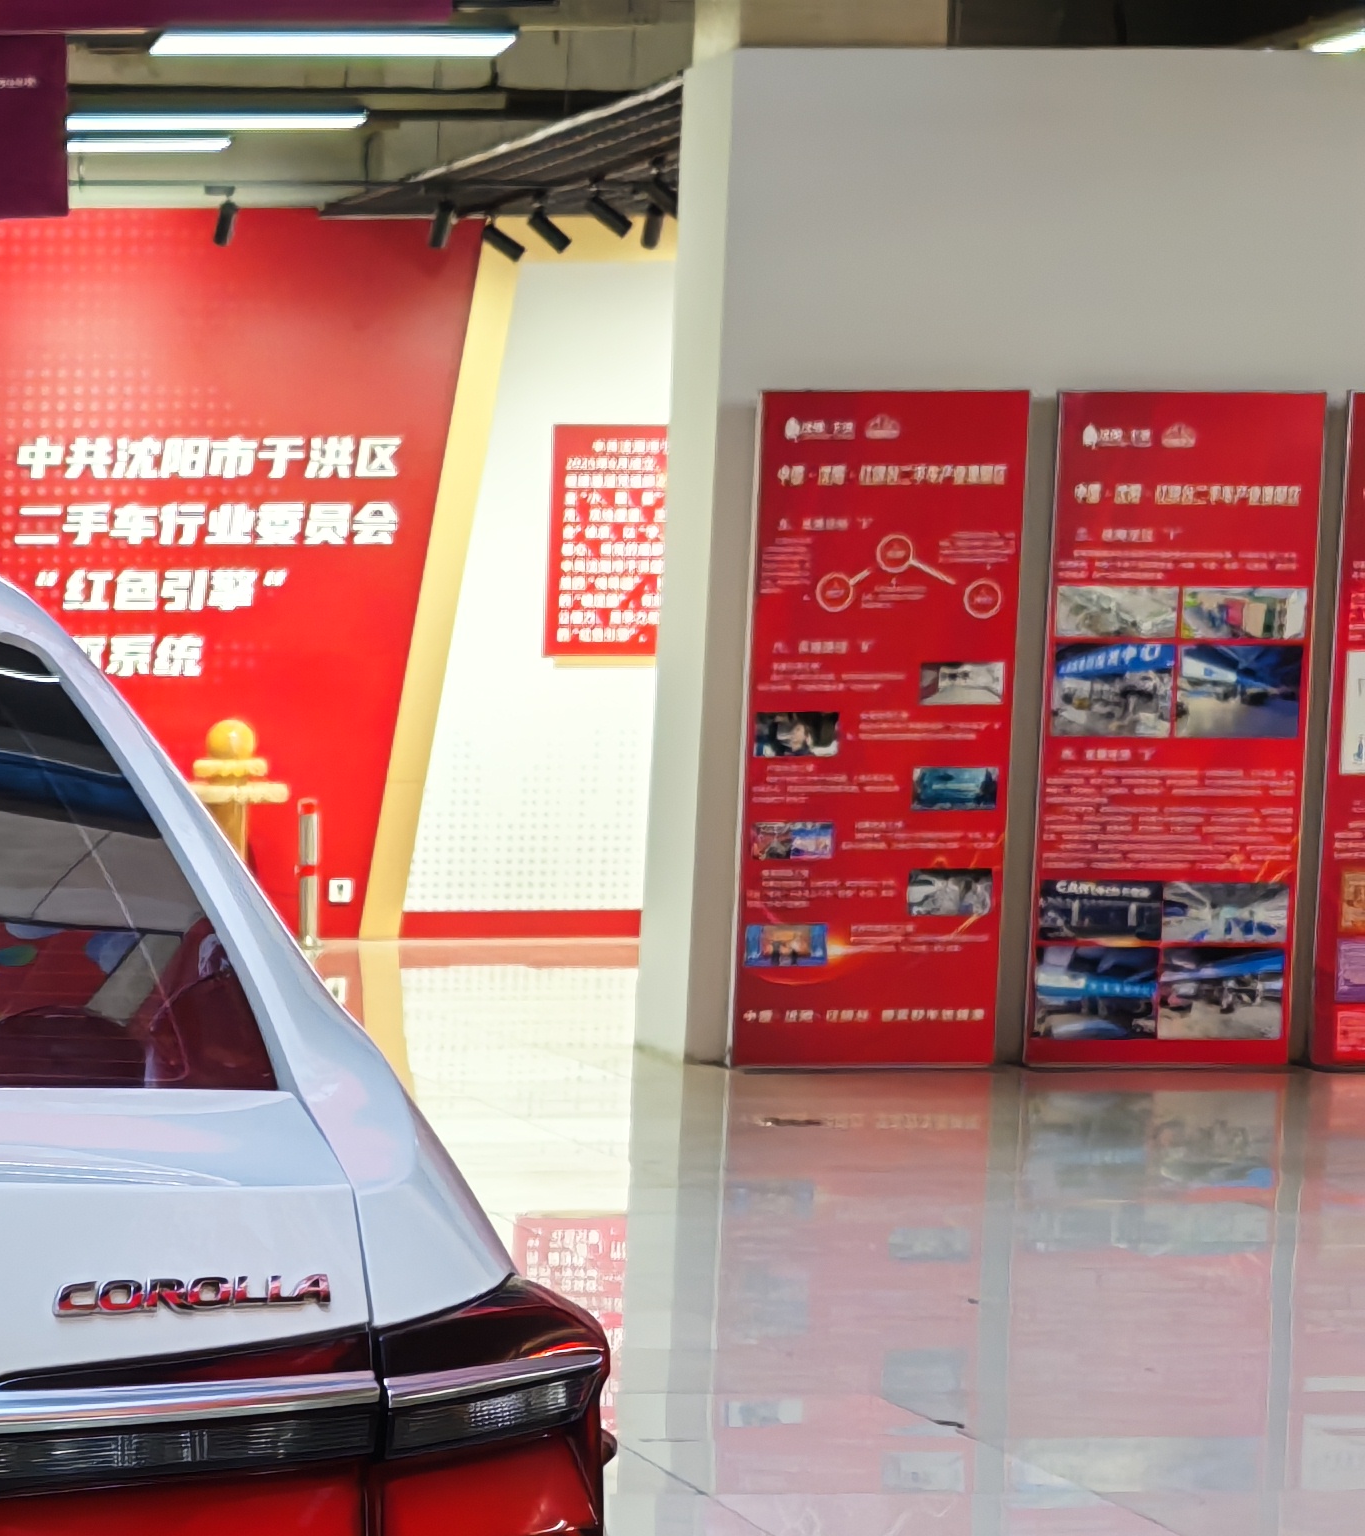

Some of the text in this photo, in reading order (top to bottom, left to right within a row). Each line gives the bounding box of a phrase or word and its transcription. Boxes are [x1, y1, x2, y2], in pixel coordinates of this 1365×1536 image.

[17, 435, 404, 479] 中共沈阳市于洪区
[13, 501, 400, 545] 二手车行业委员会
[52, 1273, 331, 1315] COROLLA
